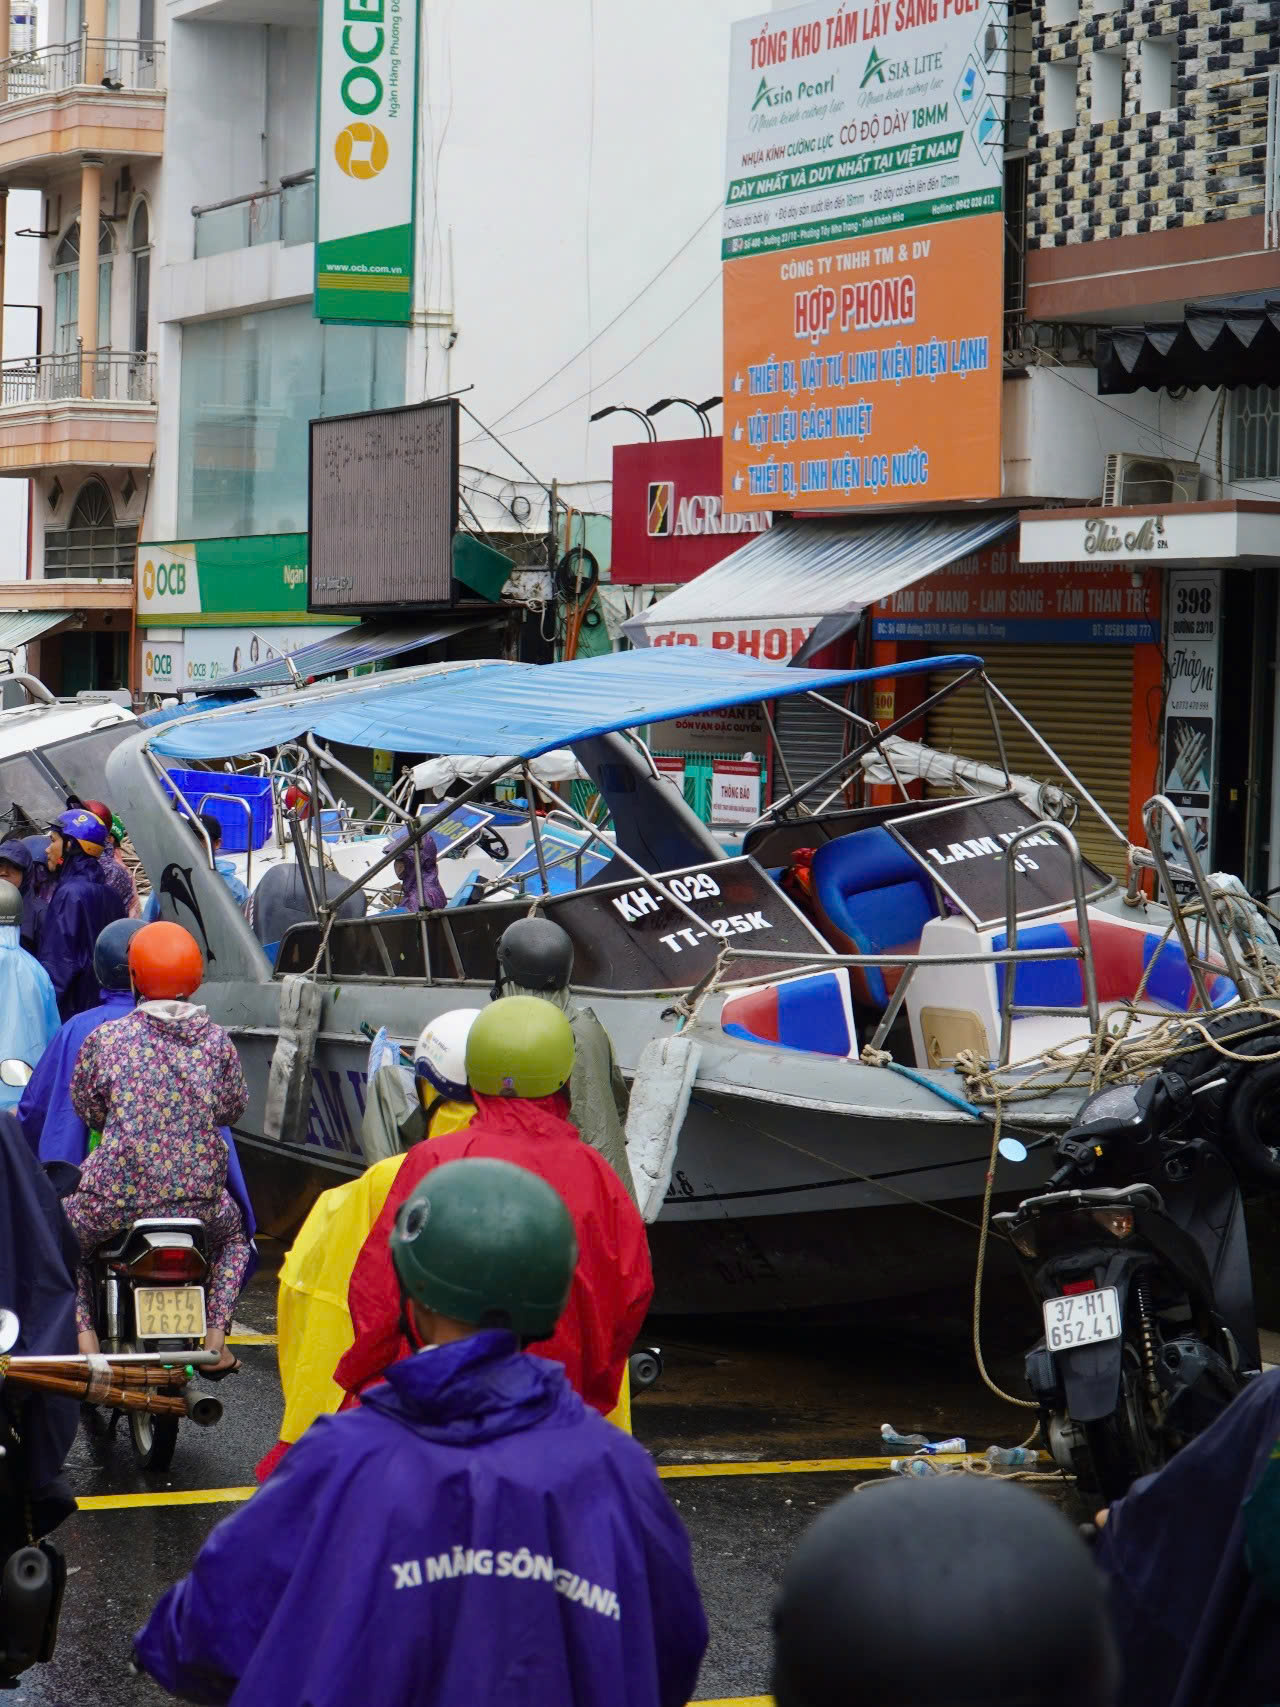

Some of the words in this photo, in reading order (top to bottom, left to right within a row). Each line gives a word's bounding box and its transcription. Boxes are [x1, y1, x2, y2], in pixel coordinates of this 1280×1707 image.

[750, 22, 787, 69] TỔNG
[791, 22, 821, 60] KHO
[826, 2, 858, 50] TẤM
[388, 59, 401, 87] Hàng
[914, 49, 943, 75] LITE
[388, 90, 401, 118] Ngân
[751, 76, 793, 112] Asia
[797, 74, 835, 101] Pearl
[741, 148, 765, 167] NHỰA
[765, 143, 786, 162] KÍNH
[787, 137, 817, 158] CƯỜNG
[840, 119, 858, 145] CÓ
[860, 112, 880, 143] ĐỘ
[883, 108, 910, 137] DÀY
[911, 102, 949, 129] 18MM
[730, 177, 756, 200] DÀY
[756, 167, 789, 196] NHẤT
[790, 168, 808, 188] VÀ
[809, 164, 836, 183] DUY
[836, 153, 871, 178] NHẤT
[873, 151, 894, 173] TẠI
[894, 145, 925, 168] VIỆT
[925, 138, 958, 157] NAM
[326, 263, 403, 274] www.ocb.com.vn
[780, 259, 814, 280] CÔNG
[817, 256, 832, 273] TY
[836, 251, 870, 271] TNHH
[874, 247, 894, 265] TM
[899, 244, 909, 262] &
[912, 240, 931, 260] DV
[794, 285, 836, 346] HỢP
[840, 275, 916, 332] PHONG
[748, 354, 780, 396] THIẾT
[801, 352, 824, 395] VẬT
[848, 350, 878, 384] LINH
[881, 341, 912, 387] KIỆN
[915, 336, 948, 382] ĐIỆN
[951, 336, 989, 379] LẠNH
[748, 408, 770, 451] VẬT
[771, 405, 798, 449] LIỆU
[801, 402, 833, 440] CÁCH
[836, 398, 873, 443] NHIỆT
[748, 454, 780, 496] THIẾT
[800, 459, 829, 492] LINH
[831, 451, 861, 496] KIỆN
[864, 454, 889, 494] LỌC
[891, 445, 929, 486] NƯỚC
[1157, 540, 1169, 549] SPA
[156, 563, 186, 596] OCB
[283, 565, 304, 590] Ngân
[936, 590, 969, 613] NANO
[980, 590, 1007, 613] LAM
[1088, 589, 1122, 613] THAN
[1177, 587, 1212, 614] 398
[1195, 621, 1213, 634] 23/10
[712, 628, 815, 661] PHON
[154, 654, 172, 675] OCB
[193, 663, 206, 678] OCB
[1172, 648, 1202, 680] Thảo
[1190, 666, 1214, 694] Mi
[675, 719, 694, 730] ĐÓN
[694, 722, 713, 733] VẠN
[714, 721, 733, 734] ĐẶC
[733, 719, 762, 733] QUYỀN
[721, 784, 738, 799] THÔNG
[739, 784, 750, 800] BÁO
[926, 836, 1005, 865] LAM
[611, 873, 721, 922] KH-029
[145, 1291, 195, 1312] 79-F4
[1054, 1292, 1105, 1323] 37-H1
[146, 1314, 194, 1334] 2622
[1051, 1314, 1114, 1347] 652.41
[391, 1560, 422, 1590] XI
